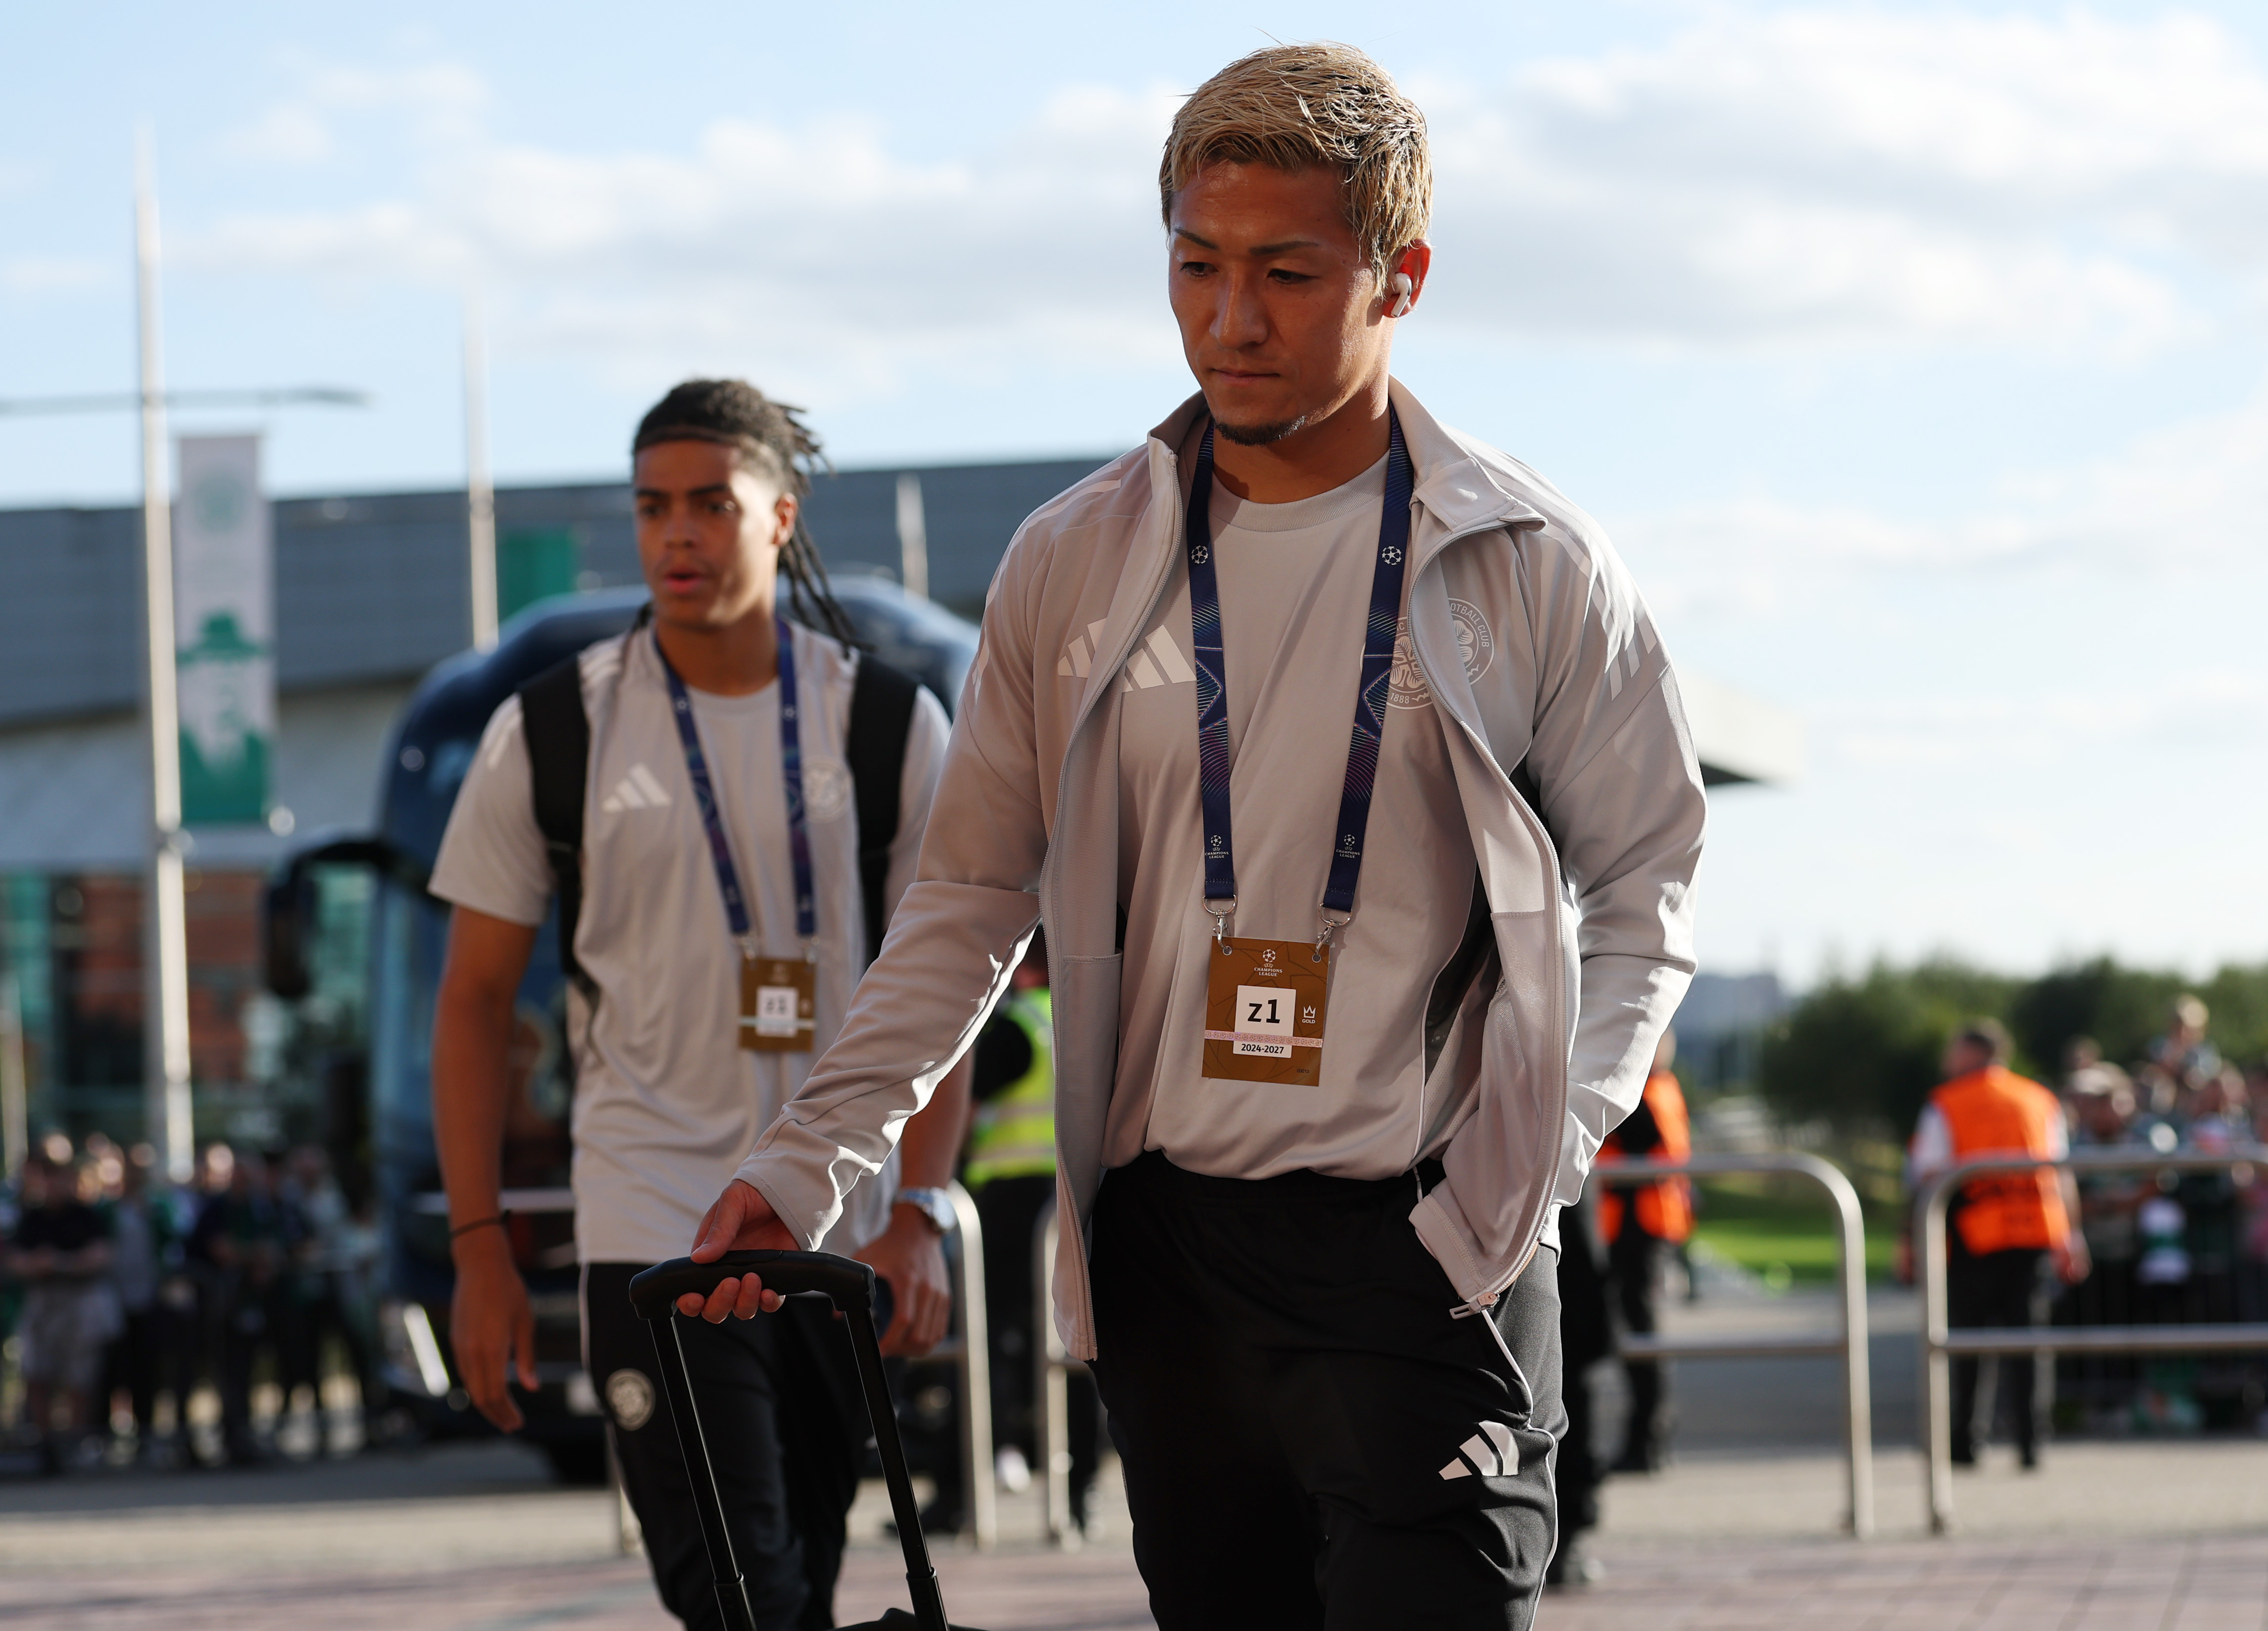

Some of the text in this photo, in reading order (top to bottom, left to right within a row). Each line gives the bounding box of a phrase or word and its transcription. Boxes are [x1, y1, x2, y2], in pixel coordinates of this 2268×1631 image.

[1450, 603, 1490, 647] OTBALL CLUB
[1390, 693, 1410, 704] 1888
[1241, 1043, 1285, 1054] 2024-2027
